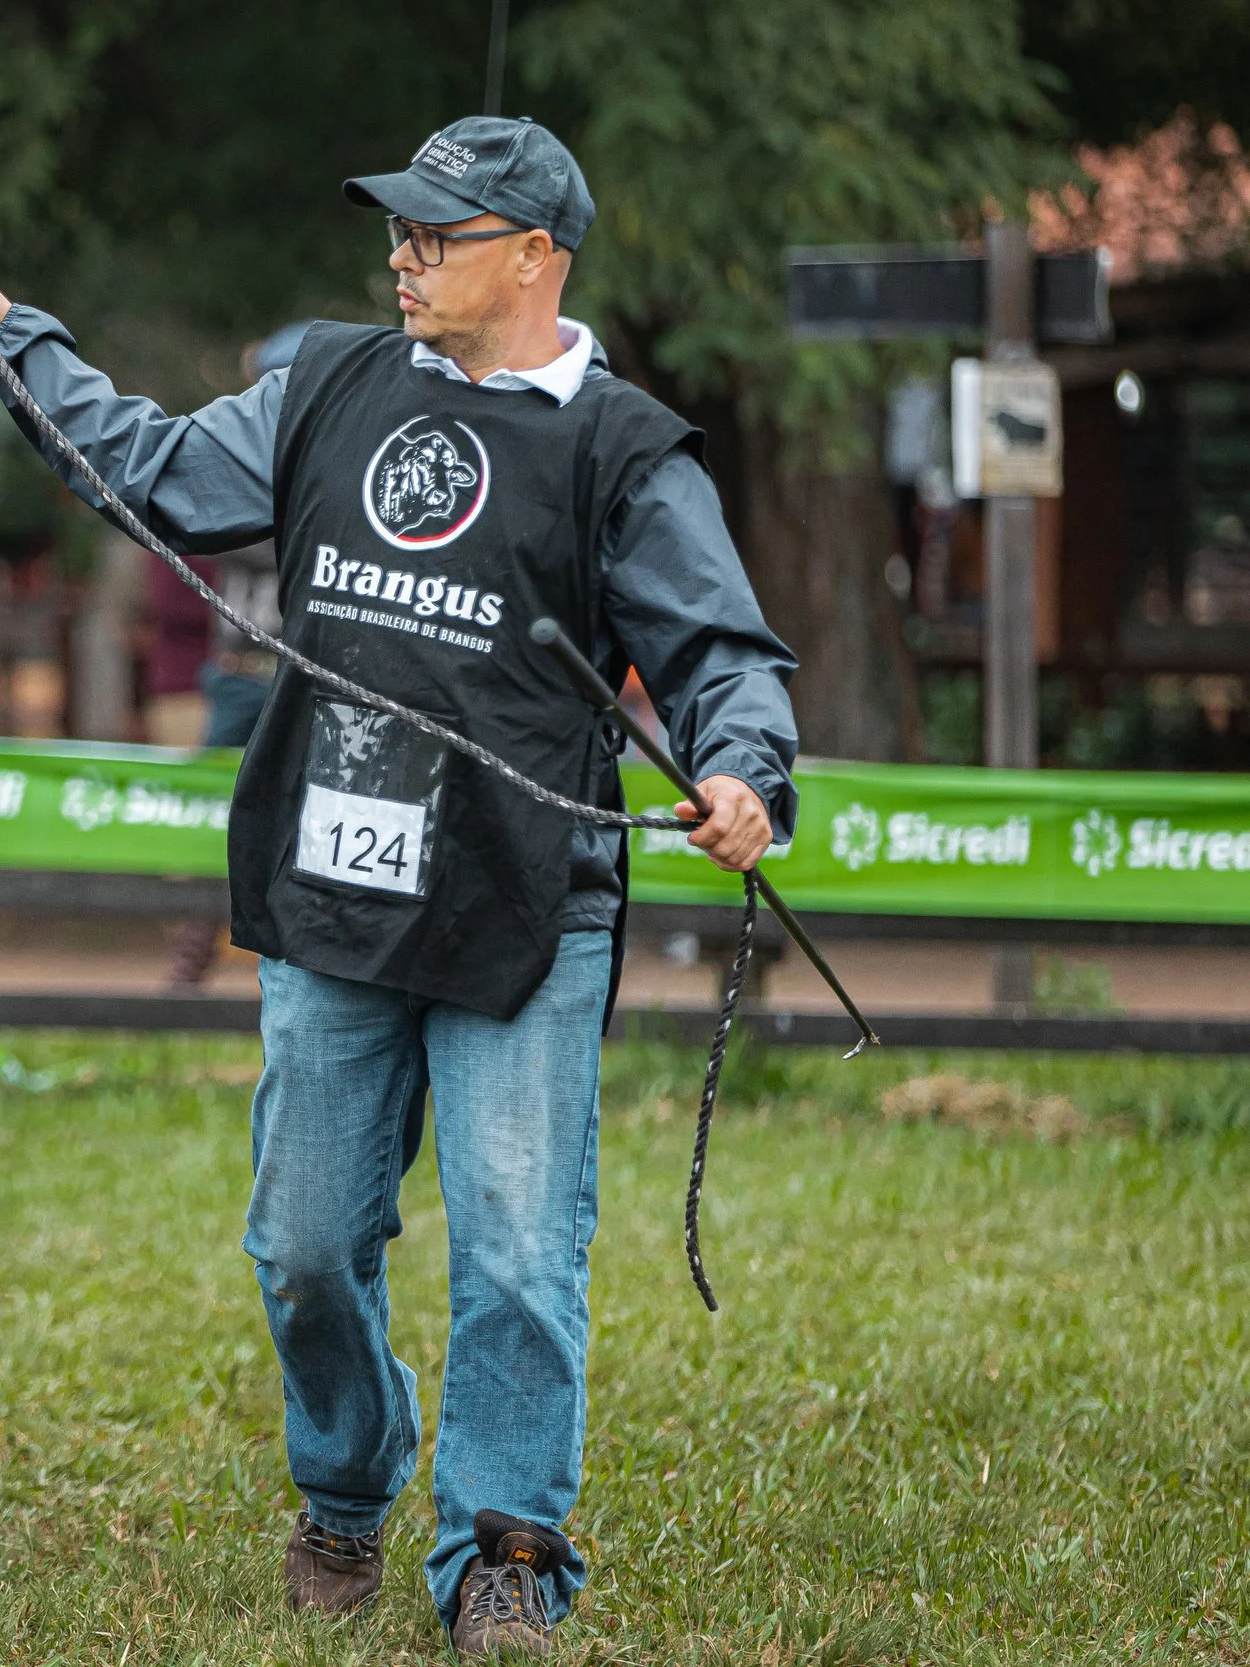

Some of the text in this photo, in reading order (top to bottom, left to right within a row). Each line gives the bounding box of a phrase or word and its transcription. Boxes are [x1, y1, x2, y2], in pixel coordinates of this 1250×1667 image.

[427, 147, 468, 173] GENÉTICA
[311, 544, 504, 626] Brangus
[359, 608, 418, 635] BRASILEIRA
[420, 622, 437, 639] DE
[439, 629, 494, 654] BRANGUS
[330, 821, 408, 877] 124
[886, 811, 1031, 866] Sicredi
